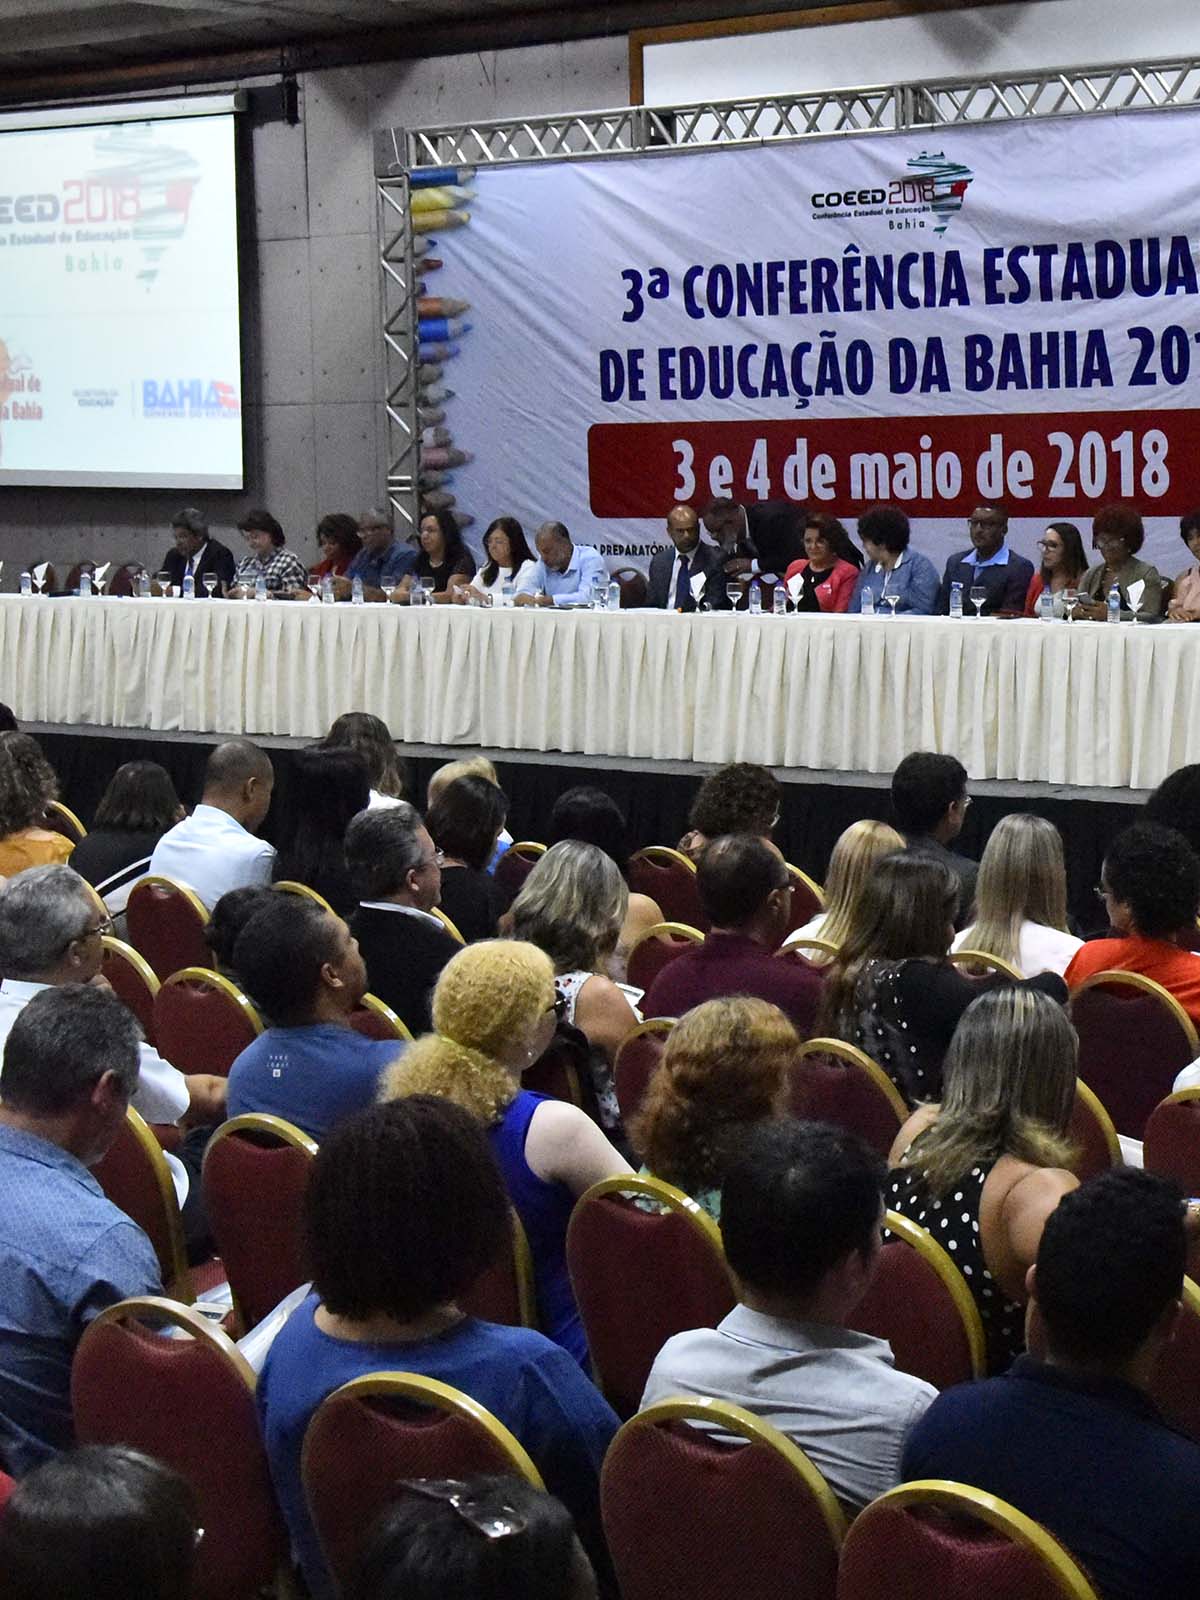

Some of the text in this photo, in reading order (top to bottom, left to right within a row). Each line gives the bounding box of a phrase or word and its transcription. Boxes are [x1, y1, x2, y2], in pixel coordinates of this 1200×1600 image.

[854, 208, 883, 217] Estadual
[885, 207, 894, 215] de
[895, 205, 931, 215] Educação
[889, 220, 925, 231] Bahia
[683, 243, 971, 320] CONFERÊNCIA
[599, 349, 647, 403] DE
[658, 329, 874, 411] EDUCAÇÃO
[888, 337, 952, 395] DA
[964, 328, 1114, 392] BAHIA
[672, 429, 1170, 501] 3 e 4 de maio de 2018
